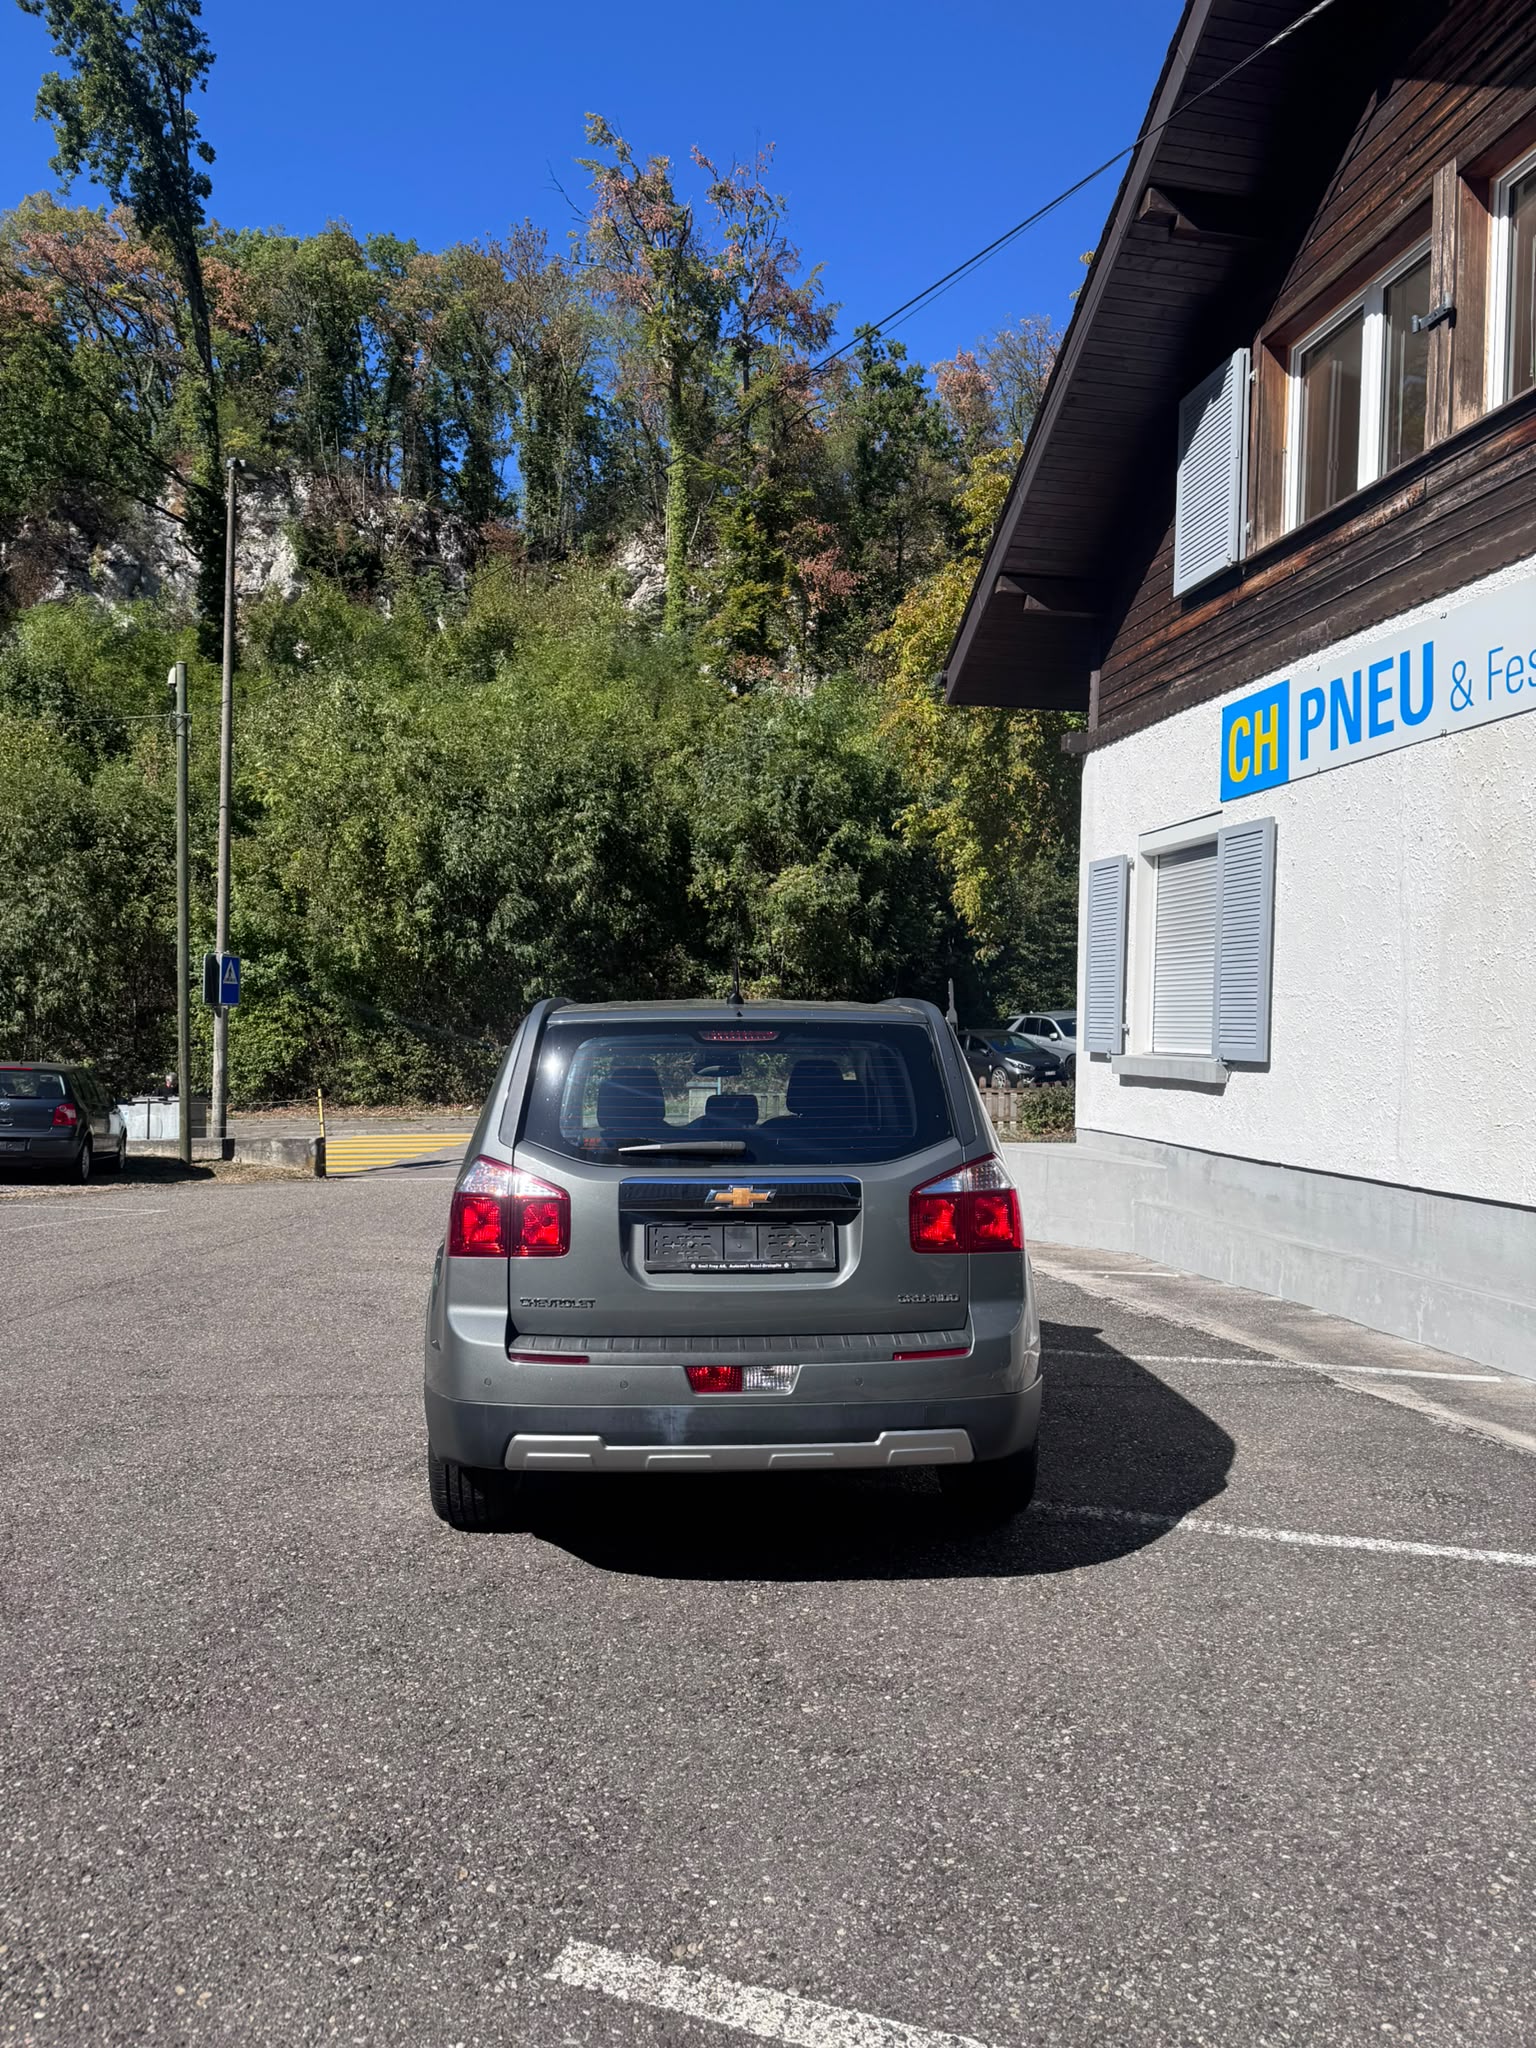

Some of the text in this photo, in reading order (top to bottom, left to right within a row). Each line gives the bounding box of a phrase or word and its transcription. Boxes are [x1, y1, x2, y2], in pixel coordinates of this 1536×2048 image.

[1227, 702, 1279, 784] CH
[1299, 640, 1434, 761] PNEU
[1449, 660, 1475, 712] &
[520, 1297, 597, 1309] CHEVROLET
